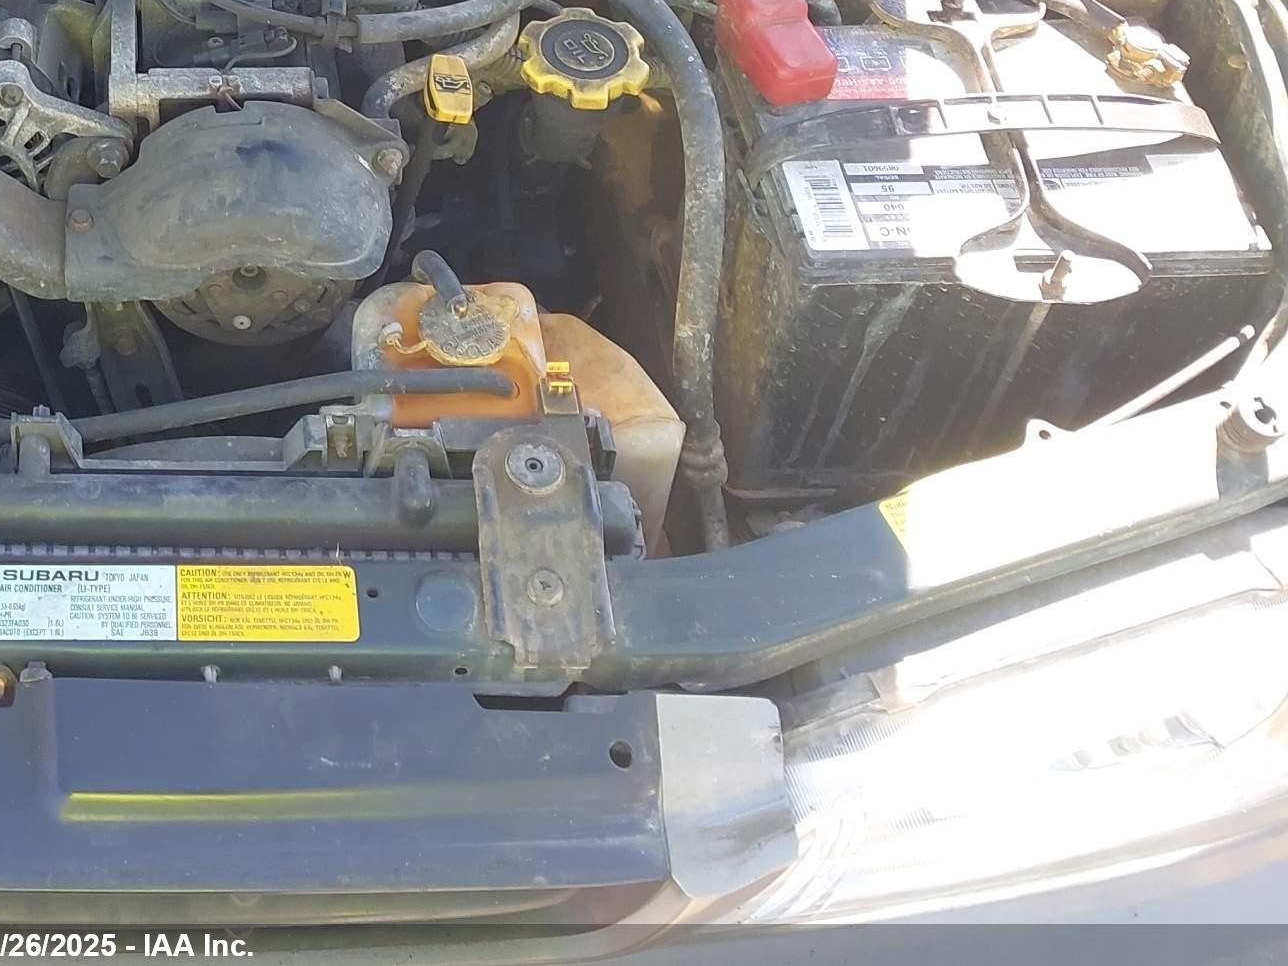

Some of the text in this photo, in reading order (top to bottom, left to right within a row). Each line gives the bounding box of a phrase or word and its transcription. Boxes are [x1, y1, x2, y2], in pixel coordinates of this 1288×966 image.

[562, 38, 587, 65] OIL
[2, 569, 149, 582] SUBARU TOKYO JAPAN
[342, 570, 352, 579] W
[0, 584, 63, 593] AIR CONDITIONER
[70, 595, 106, 603] REFRIGERANT
[107, 595, 127, 603] UNDER
[127, 595, 142, 603] HIGH
[69, 603, 95, 611] CONSULT
[96, 603, 119, 611] SERVICE
[97, 612, 121, 620] SYSTEM
[122, 612, 130, 620] TO
[100, 620, 109, 629] BY
[110, 621, 139, 629] QUALIFIED
[110, 628, 124, 637] SAE
